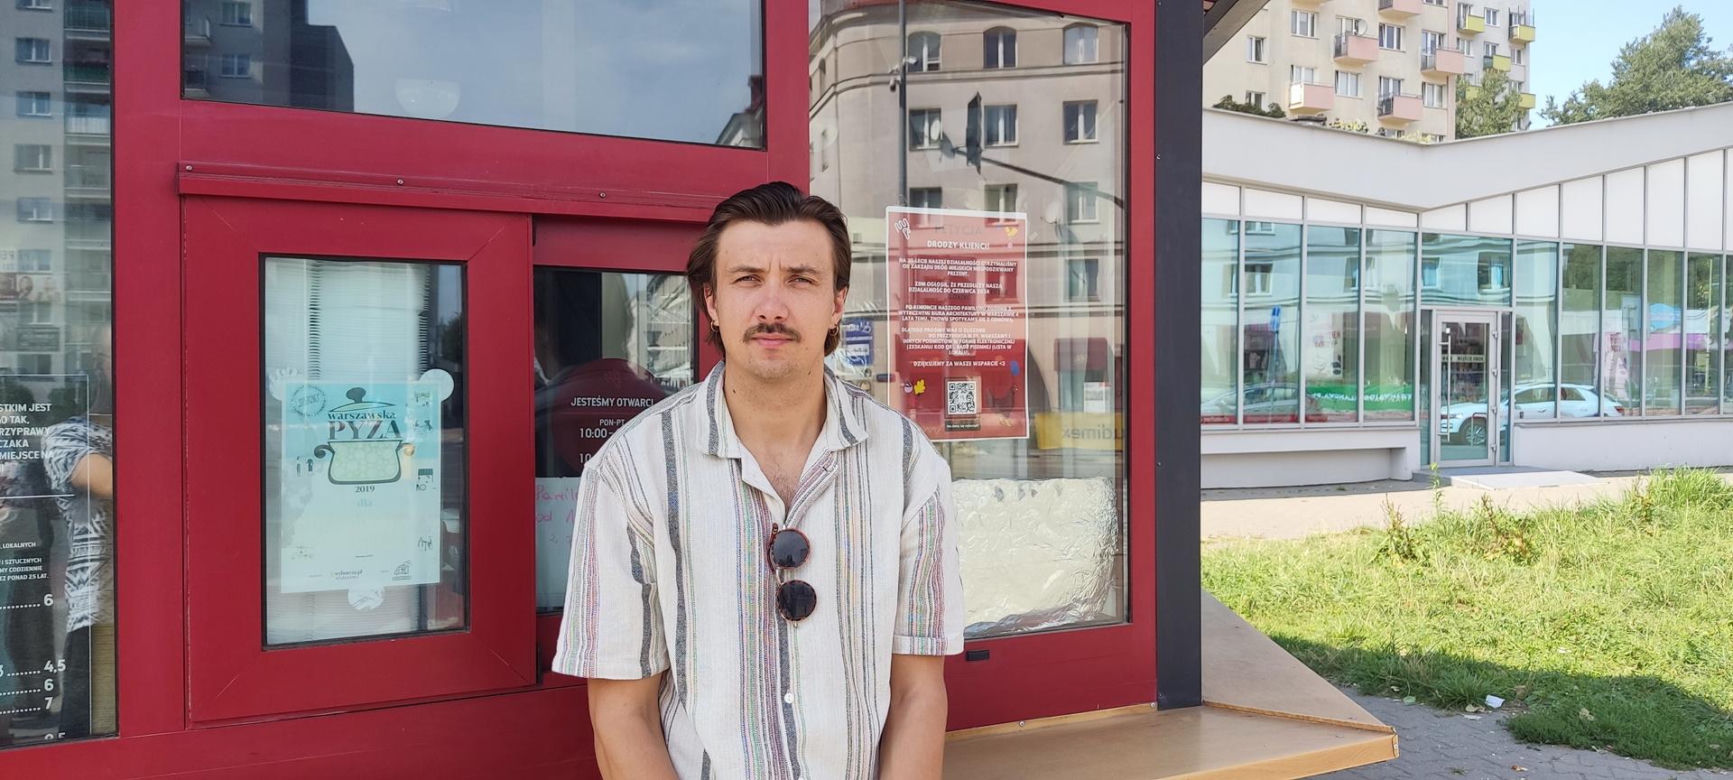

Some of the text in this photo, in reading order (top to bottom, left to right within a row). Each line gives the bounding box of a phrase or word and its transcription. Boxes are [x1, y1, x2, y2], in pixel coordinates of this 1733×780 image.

[927, 240, 957, 249] DRODZY
[570, 395, 654, 407] JESTEŚMY OTWARCI
[28, 403, 52, 412] JEST
[328, 410, 396, 420] warszawska
[328, 420, 402, 440] PYZA
[579, 428, 607, 438] 10:00
[355, 485, 375, 493] 2019
[43, 593, 54, 607] 6
[43, 659, 66, 674] 4,5
[44, 678, 54, 691] 6
[44, 696, 54, 710] 7
